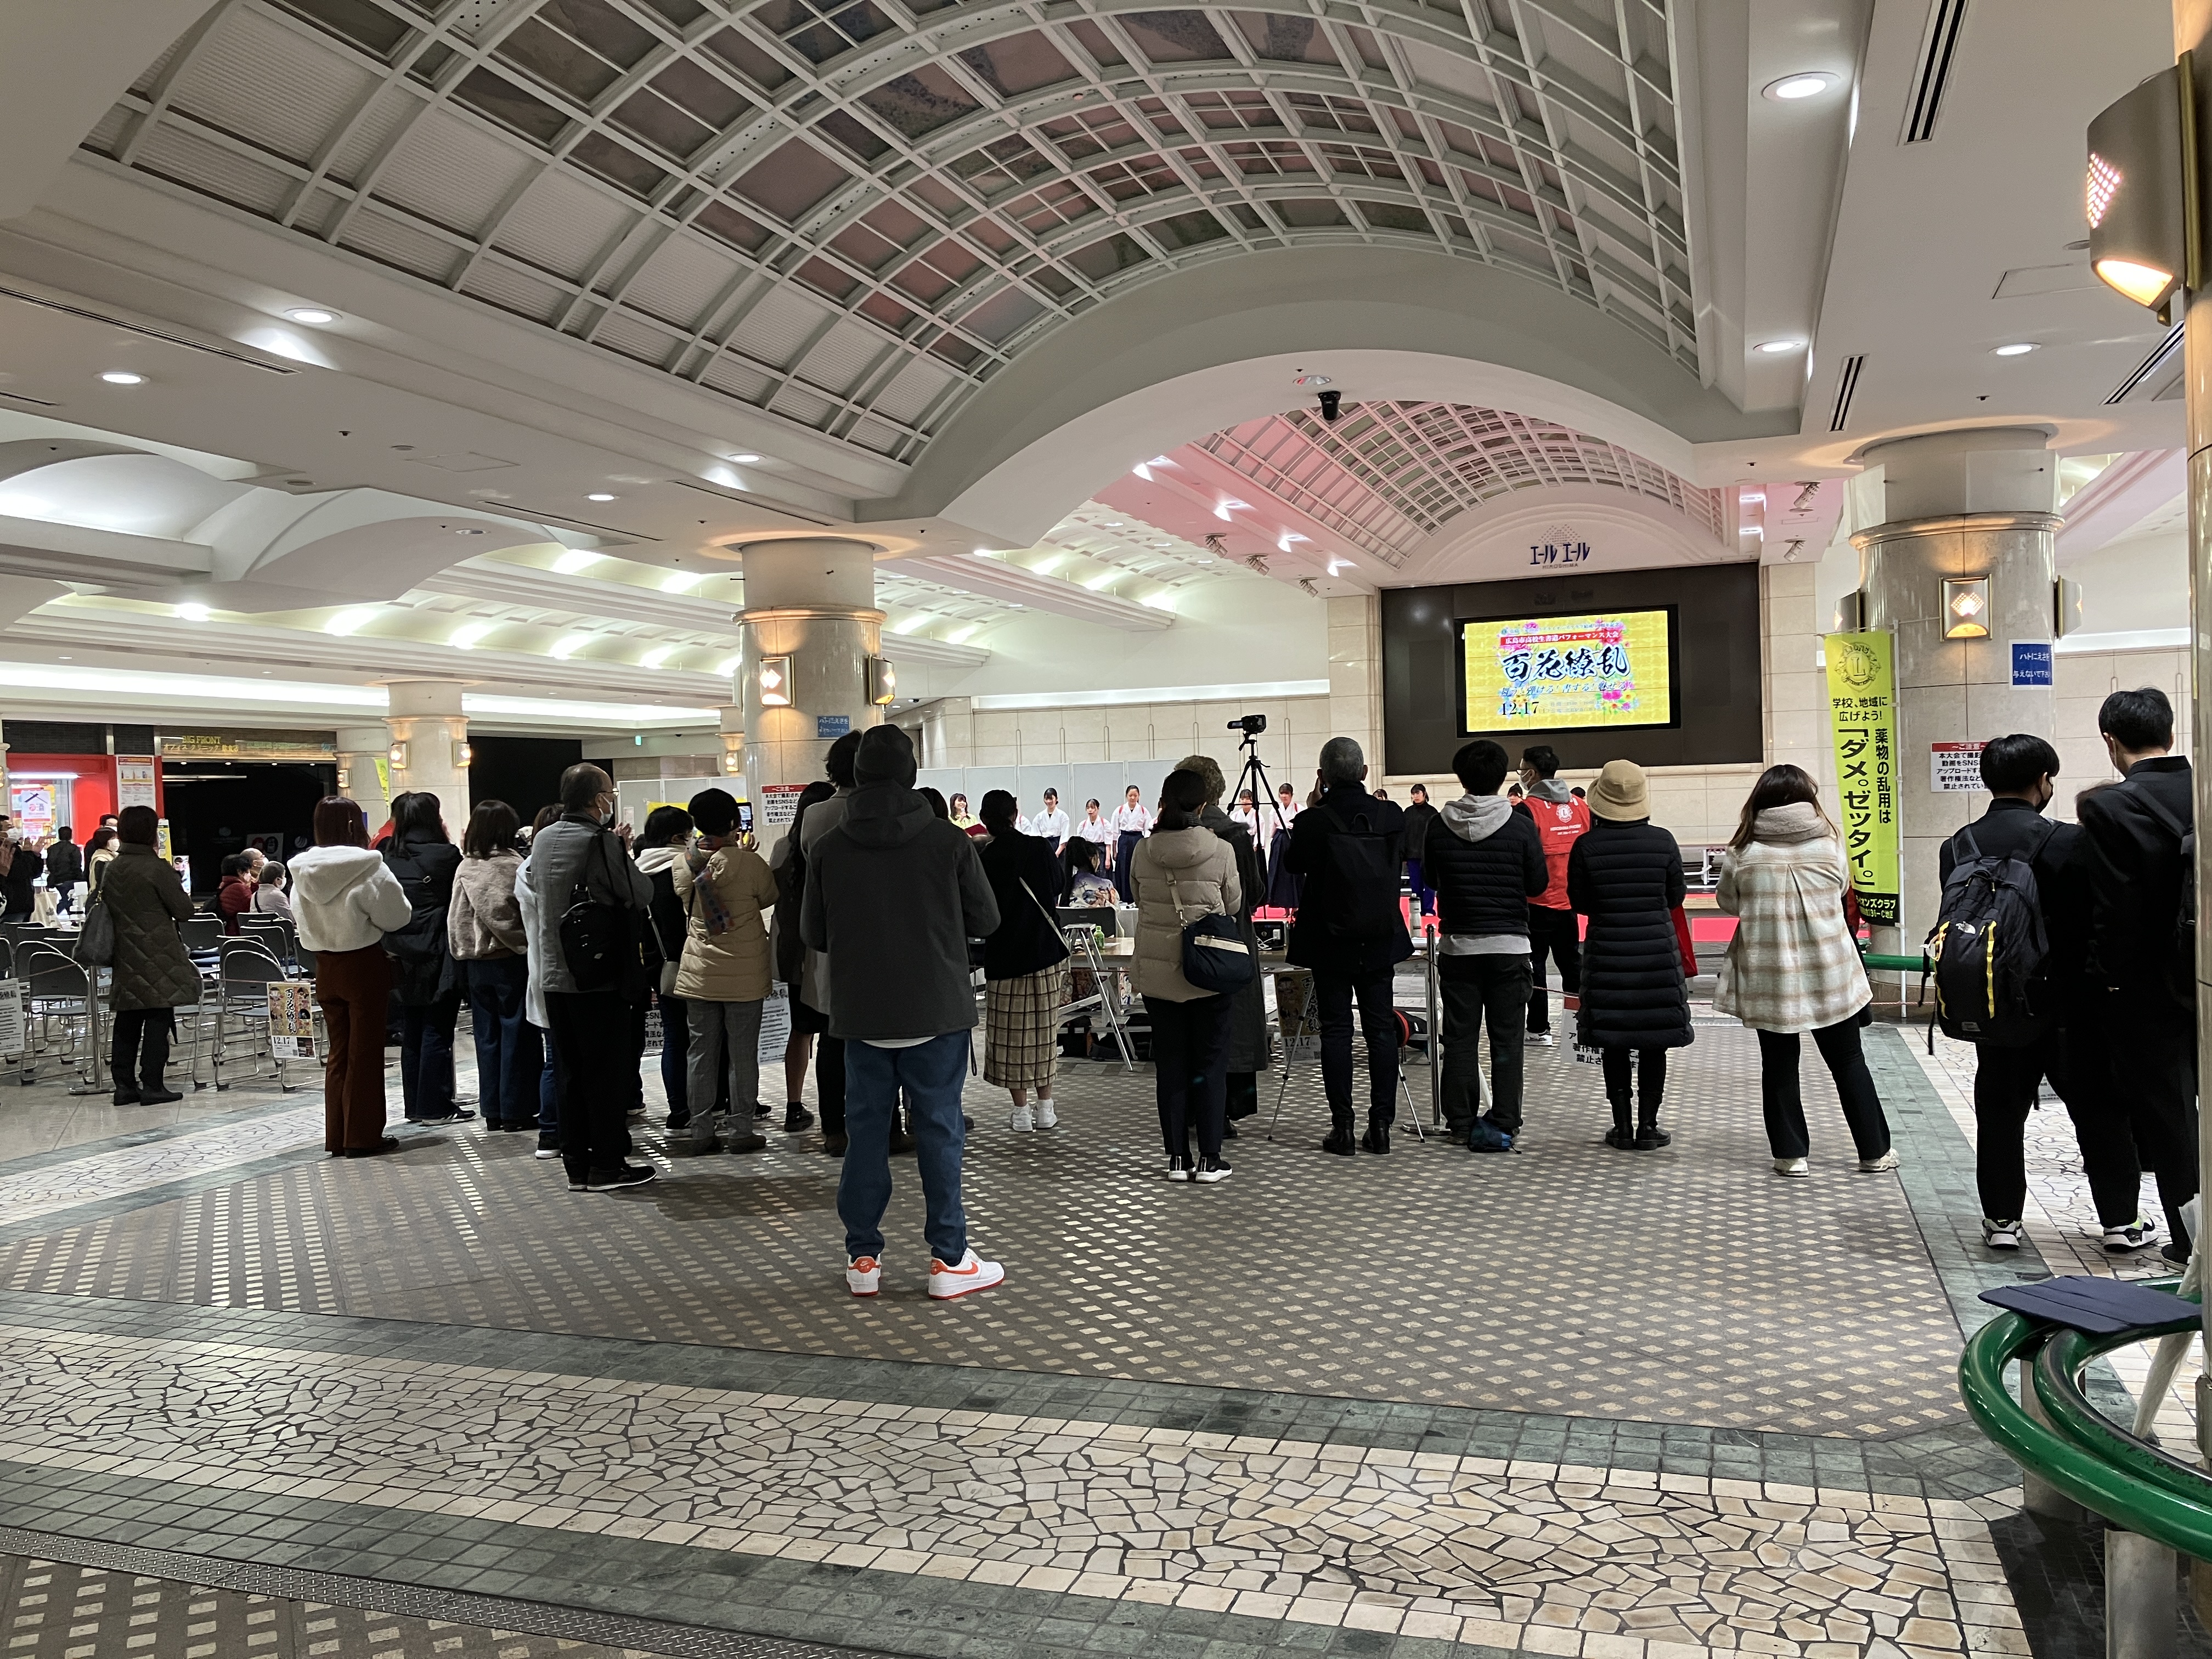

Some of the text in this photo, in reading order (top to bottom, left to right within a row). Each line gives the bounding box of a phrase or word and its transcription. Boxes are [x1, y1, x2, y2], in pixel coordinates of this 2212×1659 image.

[1530, 543, 1590, 565] エール エール
[1505, 631, 1619, 645] 広島市高校生書道パフォーマンス大会
[1503, 646, 1628, 680] 百花繚乱
[2019, 652, 2050, 661] ハトにえさを
[1502, 702, 1539, 715] 12.17
[1833, 696, 1888, 708] 学校、地域に
[1839, 711, 1882, 721] 広げよう!
[196, 736, 221, 744] FRONT
[1875, 728, 1891, 824] 薬物の乱用は
